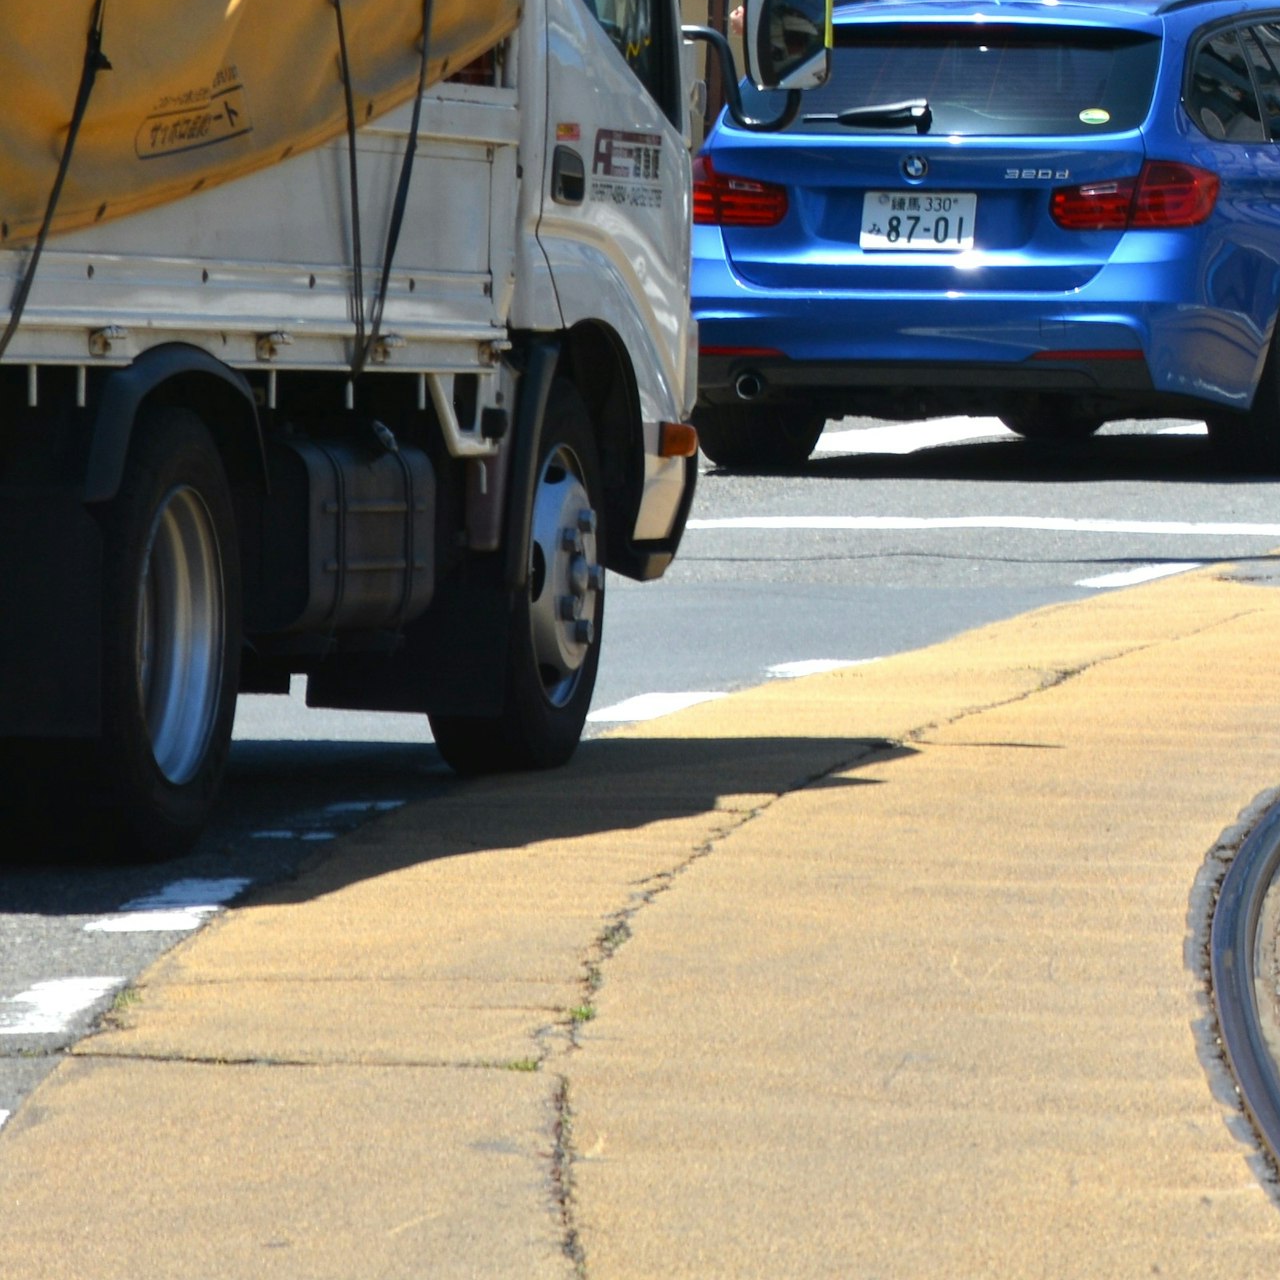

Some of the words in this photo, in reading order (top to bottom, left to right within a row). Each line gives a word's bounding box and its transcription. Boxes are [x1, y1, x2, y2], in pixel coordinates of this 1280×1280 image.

[1004, 169, 1070, 180] 320d
[891, 197, 921, 212] 練馬
[924, 198, 953, 212] 330
[886, 216, 964, 244] 87-01
